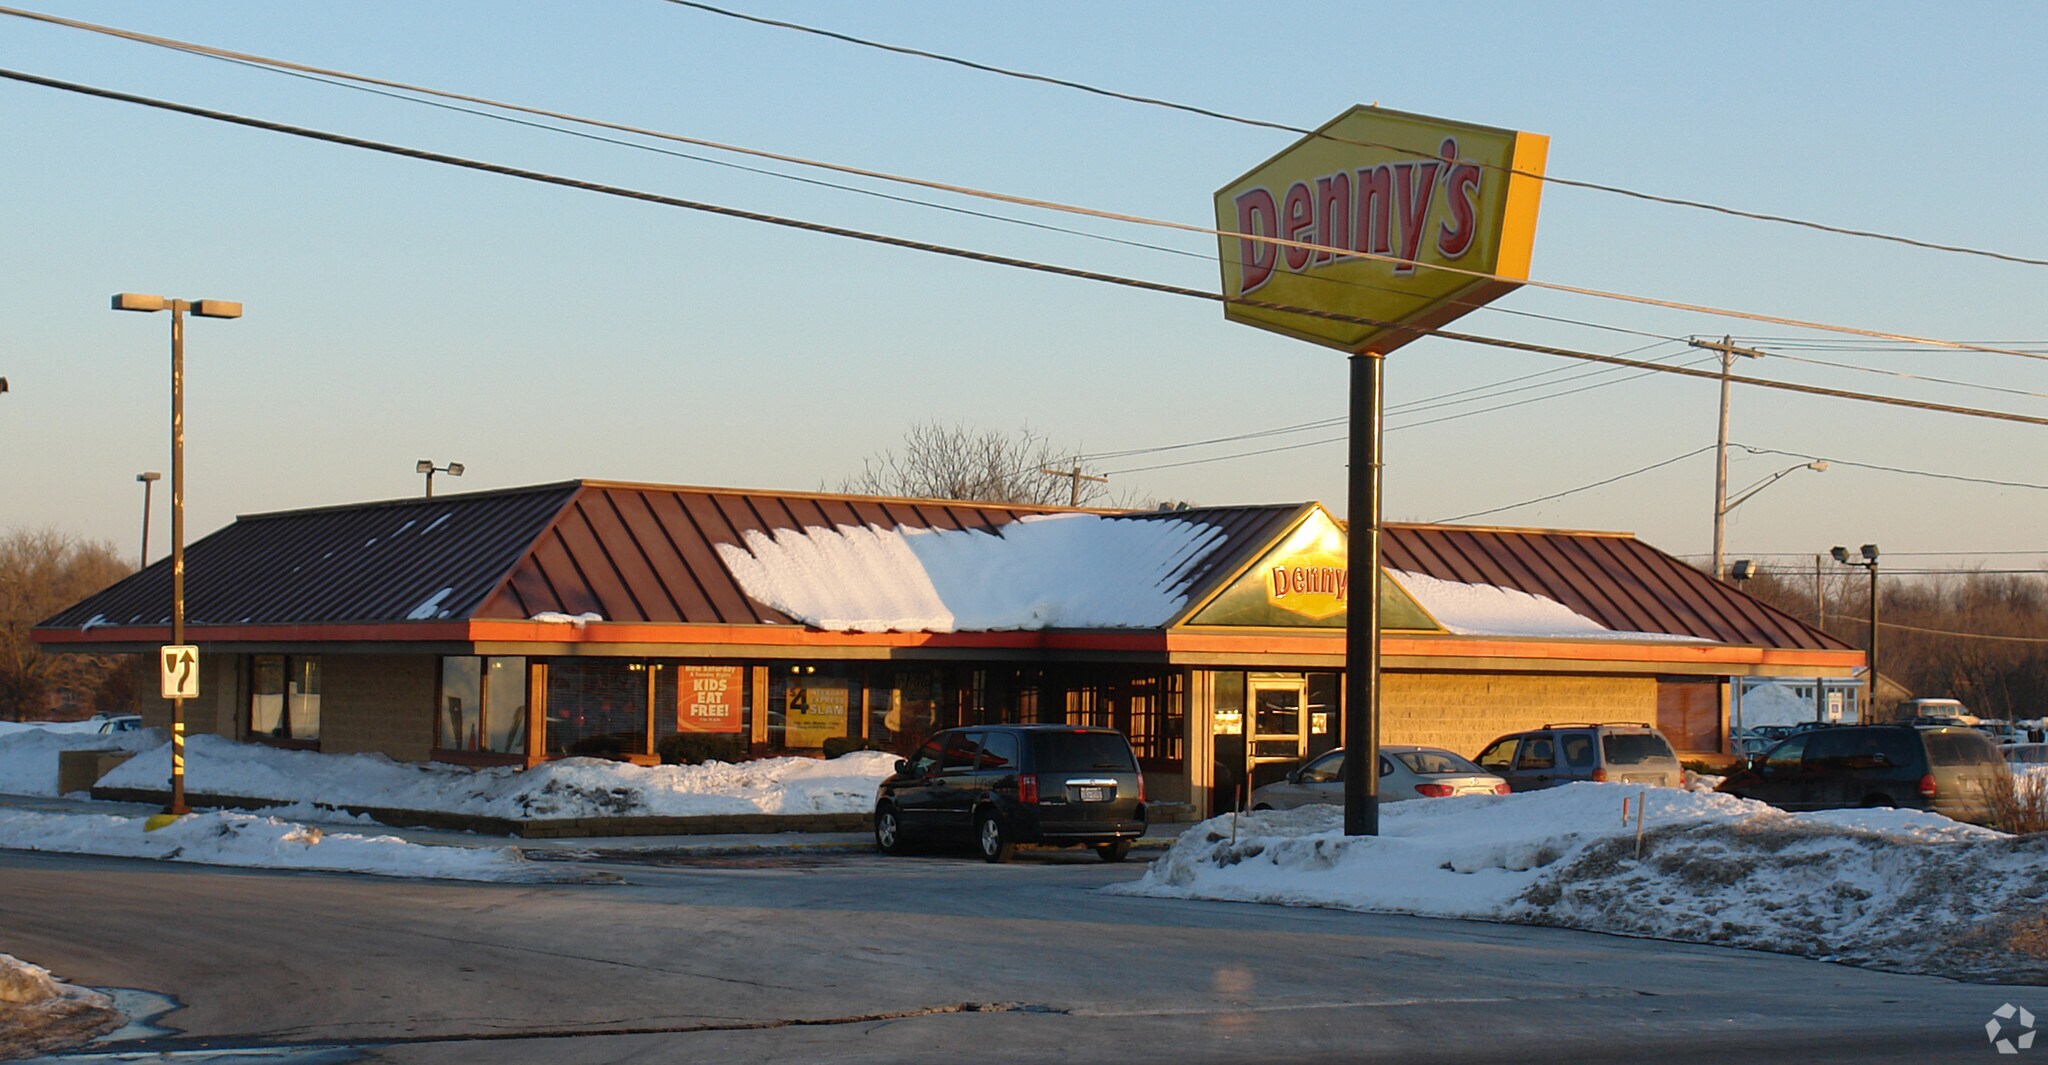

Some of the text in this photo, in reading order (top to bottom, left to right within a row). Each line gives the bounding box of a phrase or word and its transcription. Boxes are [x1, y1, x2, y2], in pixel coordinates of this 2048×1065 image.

[1234, 136, 1481, 295] Denny's
[1272, 565, 1348, 600] Denny
[693, 679, 728, 692] KIDS
[697, 691, 723, 704] EAT
[690, 703, 729, 717] FREE!
[810, 704, 844, 715] SLAM
